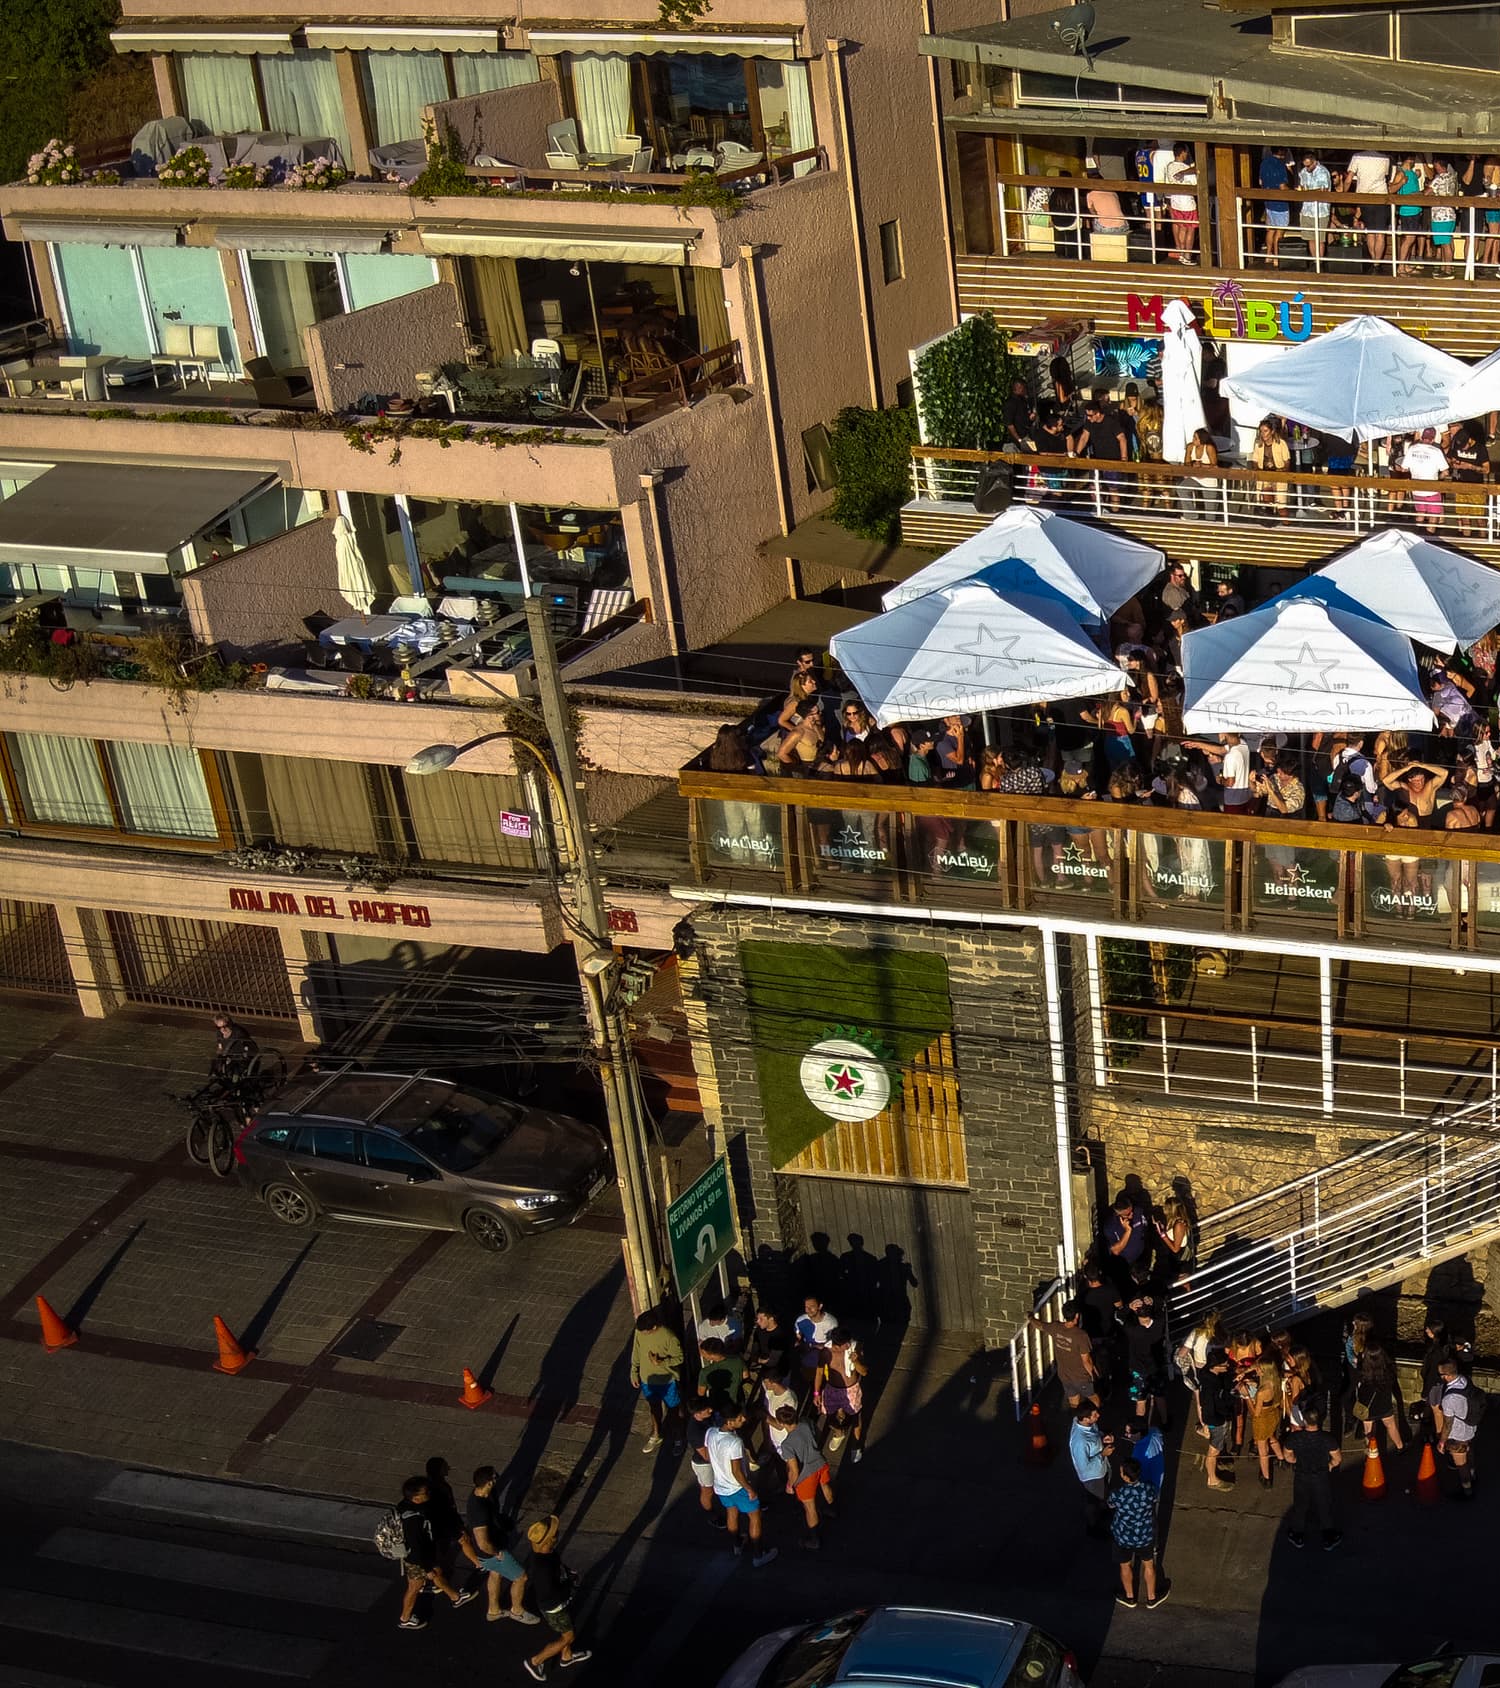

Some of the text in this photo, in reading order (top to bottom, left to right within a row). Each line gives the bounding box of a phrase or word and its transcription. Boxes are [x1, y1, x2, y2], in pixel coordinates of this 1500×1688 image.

[1127, 279, 1312, 342] MLIBÚ
[894, 673, 1111, 720] Heineken
[719, 835, 770, 852] MALIBÚ
[820, 844, 887, 861] Heineken
[936, 852, 988, 868] MALIBÚ
[1157, 871, 1210, 888] MALIBÚ
[1264, 882, 1333, 900] Heineken
[1380, 890, 1433, 907] MALIBÚ
[228, 887, 432, 928] ATALAYA DEL PACIFICO
[669, 1164, 725, 1226] RETORNO VEHICULOS
[675, 1205, 703, 1240] LIVIANOS
